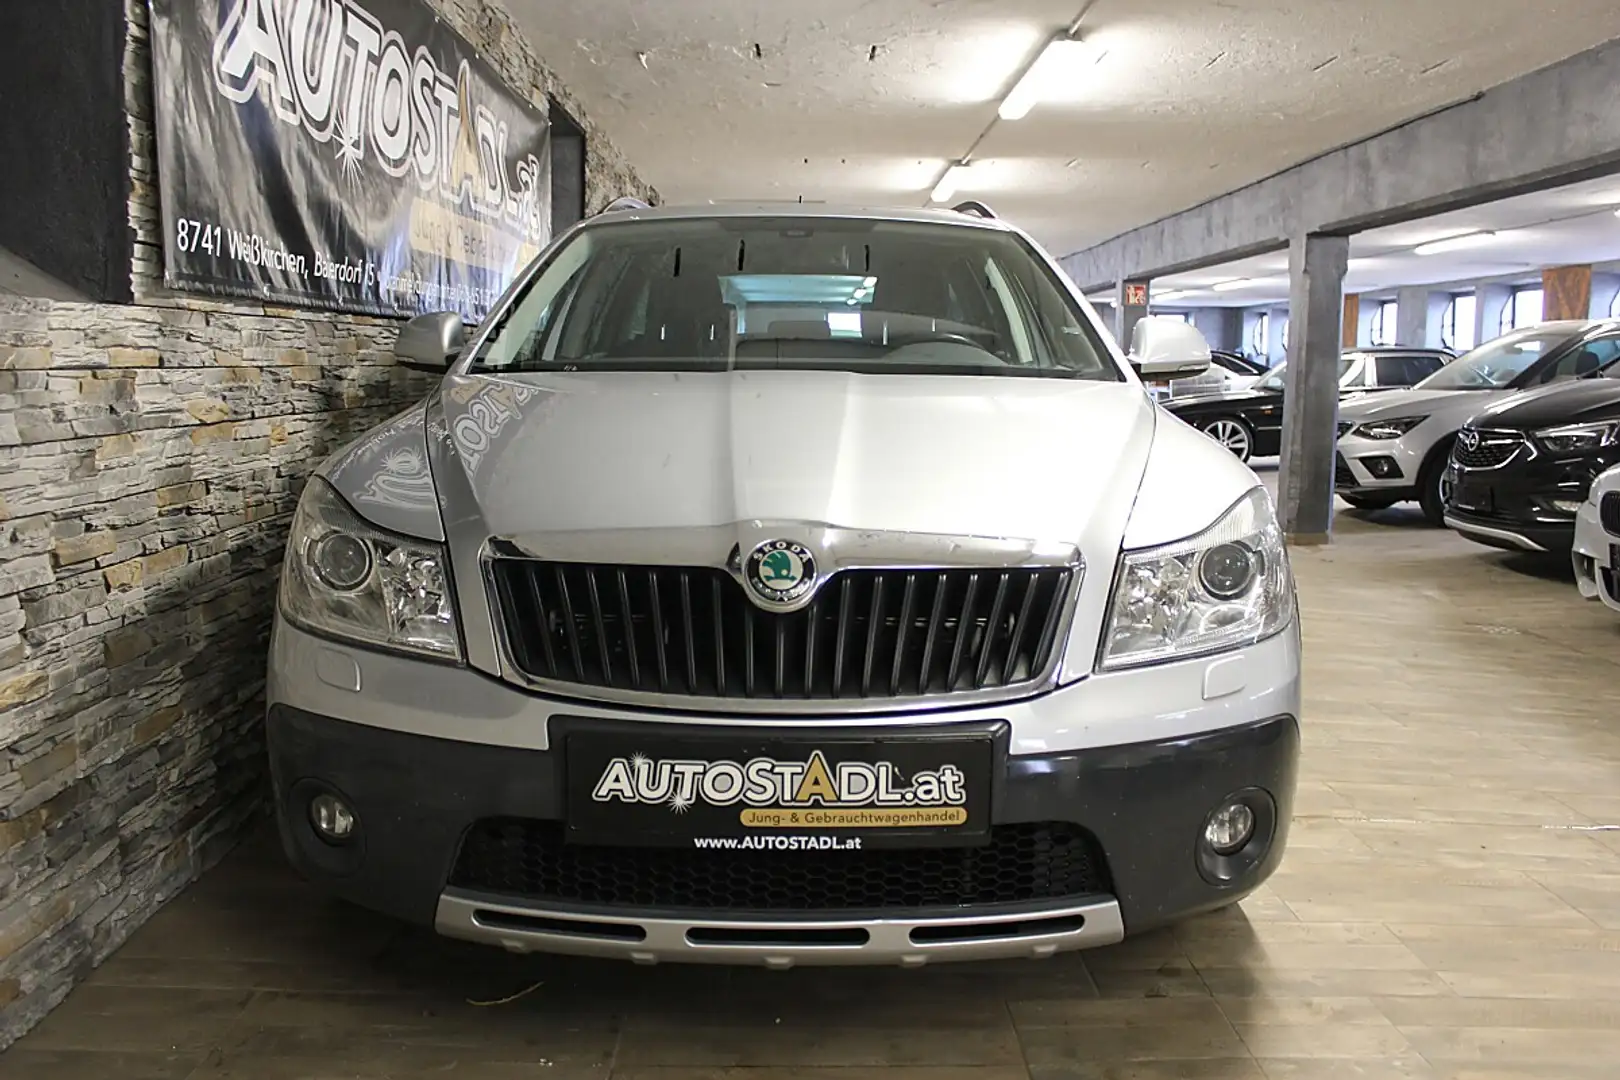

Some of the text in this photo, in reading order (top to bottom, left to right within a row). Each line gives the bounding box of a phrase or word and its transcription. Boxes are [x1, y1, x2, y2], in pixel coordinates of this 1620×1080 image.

[177, 217, 222, 258] 8741
[226, 227, 308, 280] Weißkirchen,
[314, 251, 363, 284] Baierdorf
[592, 750, 968, 805] AUTOSTADL.at
[749, 810, 960, 825] Jung- & Gebrauchtwagenhandel
[694, 835, 862, 850] www.AUTOSTADL.at
